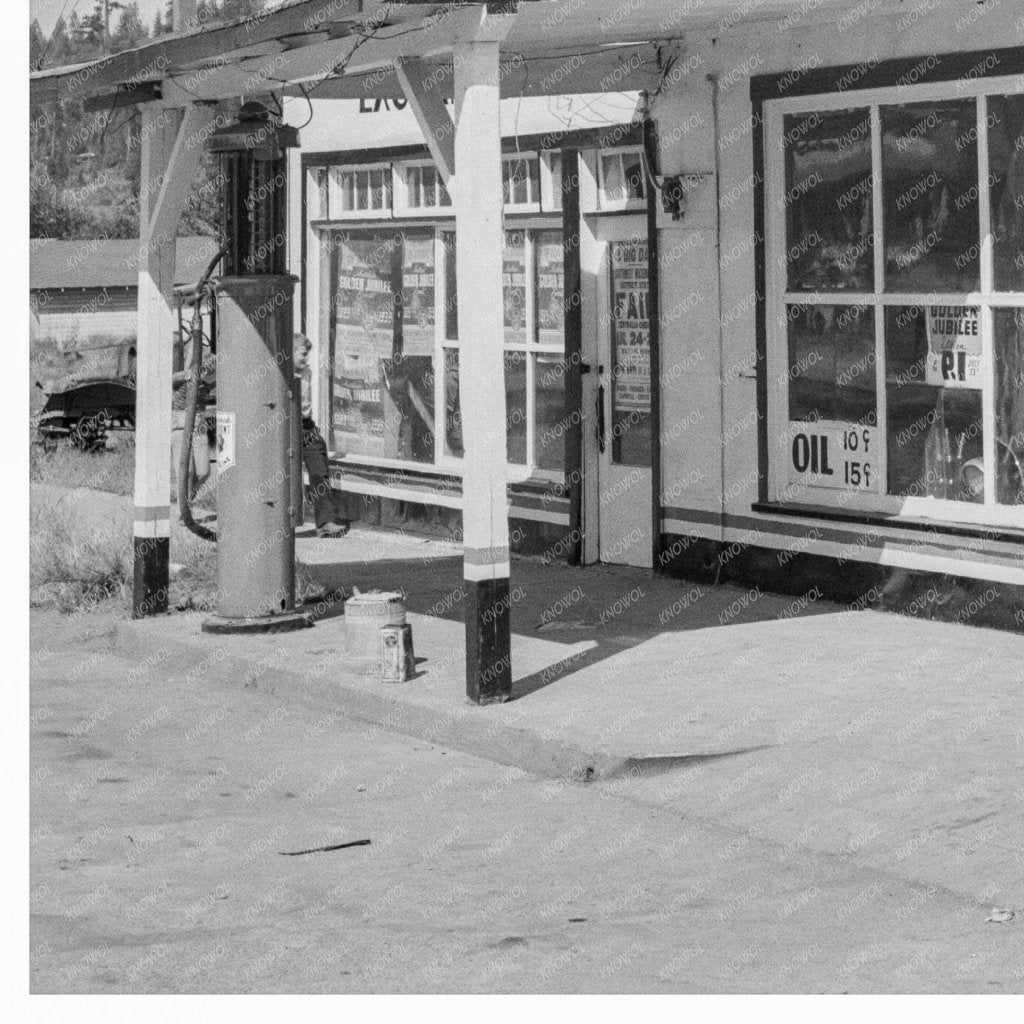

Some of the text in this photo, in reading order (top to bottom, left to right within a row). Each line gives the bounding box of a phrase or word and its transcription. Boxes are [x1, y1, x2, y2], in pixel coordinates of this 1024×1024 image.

[638, 247, 649, 262] DA
[930, 305, 978, 318] GOLDEN
[932, 320, 978, 336] JUBILEE
[792, 433, 834, 475] OIL
